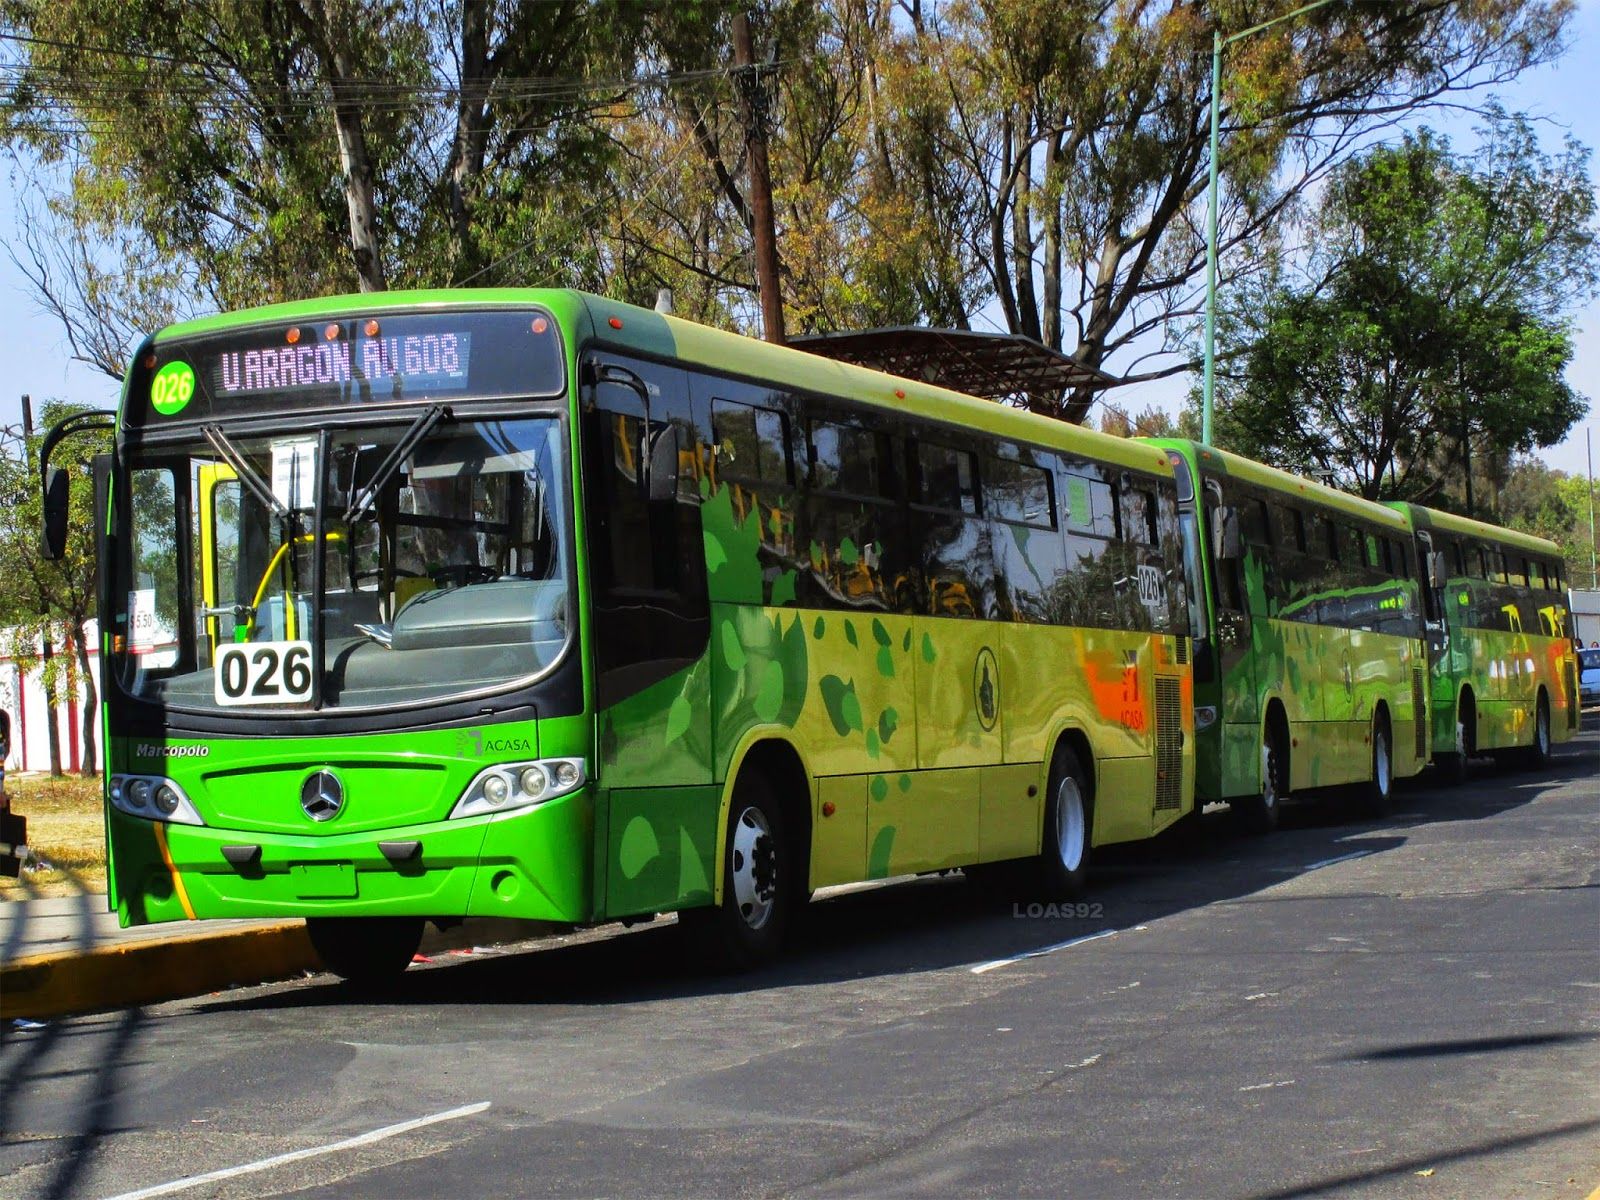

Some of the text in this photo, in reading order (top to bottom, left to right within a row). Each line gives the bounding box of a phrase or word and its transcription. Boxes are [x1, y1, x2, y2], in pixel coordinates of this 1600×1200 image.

[153, 371, 192, 405] 026
[1140, 568, 1159, 601] 026
[221, 646, 312, 698] 026
[136, 743, 210, 758] Marcopolo
[485, 739, 531, 752] ACASA
